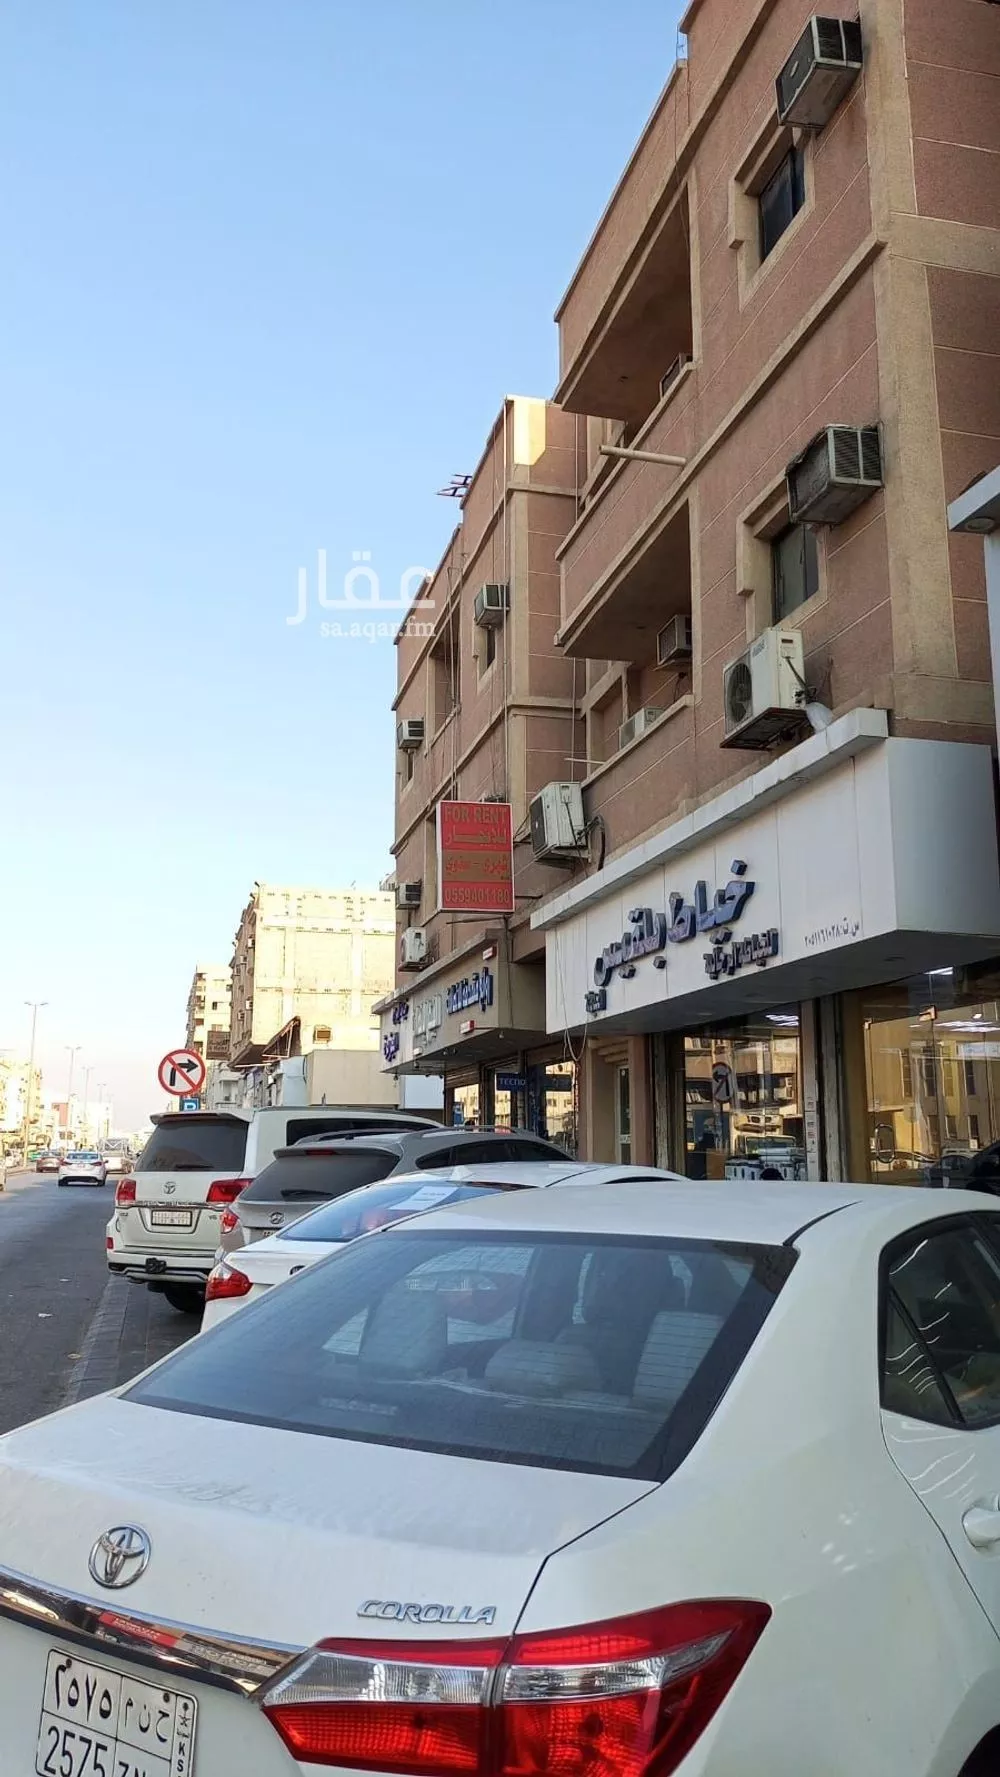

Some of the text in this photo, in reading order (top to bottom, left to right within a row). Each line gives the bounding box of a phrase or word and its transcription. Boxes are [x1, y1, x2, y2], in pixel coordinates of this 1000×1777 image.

[444, 806, 508, 823] FOR RENT
[357, 1600, 497, 1625] COROLLA
[55, 1664, 112, 1720] ٢٥٧٥
[44, 1725, 108, 1777] 2575
